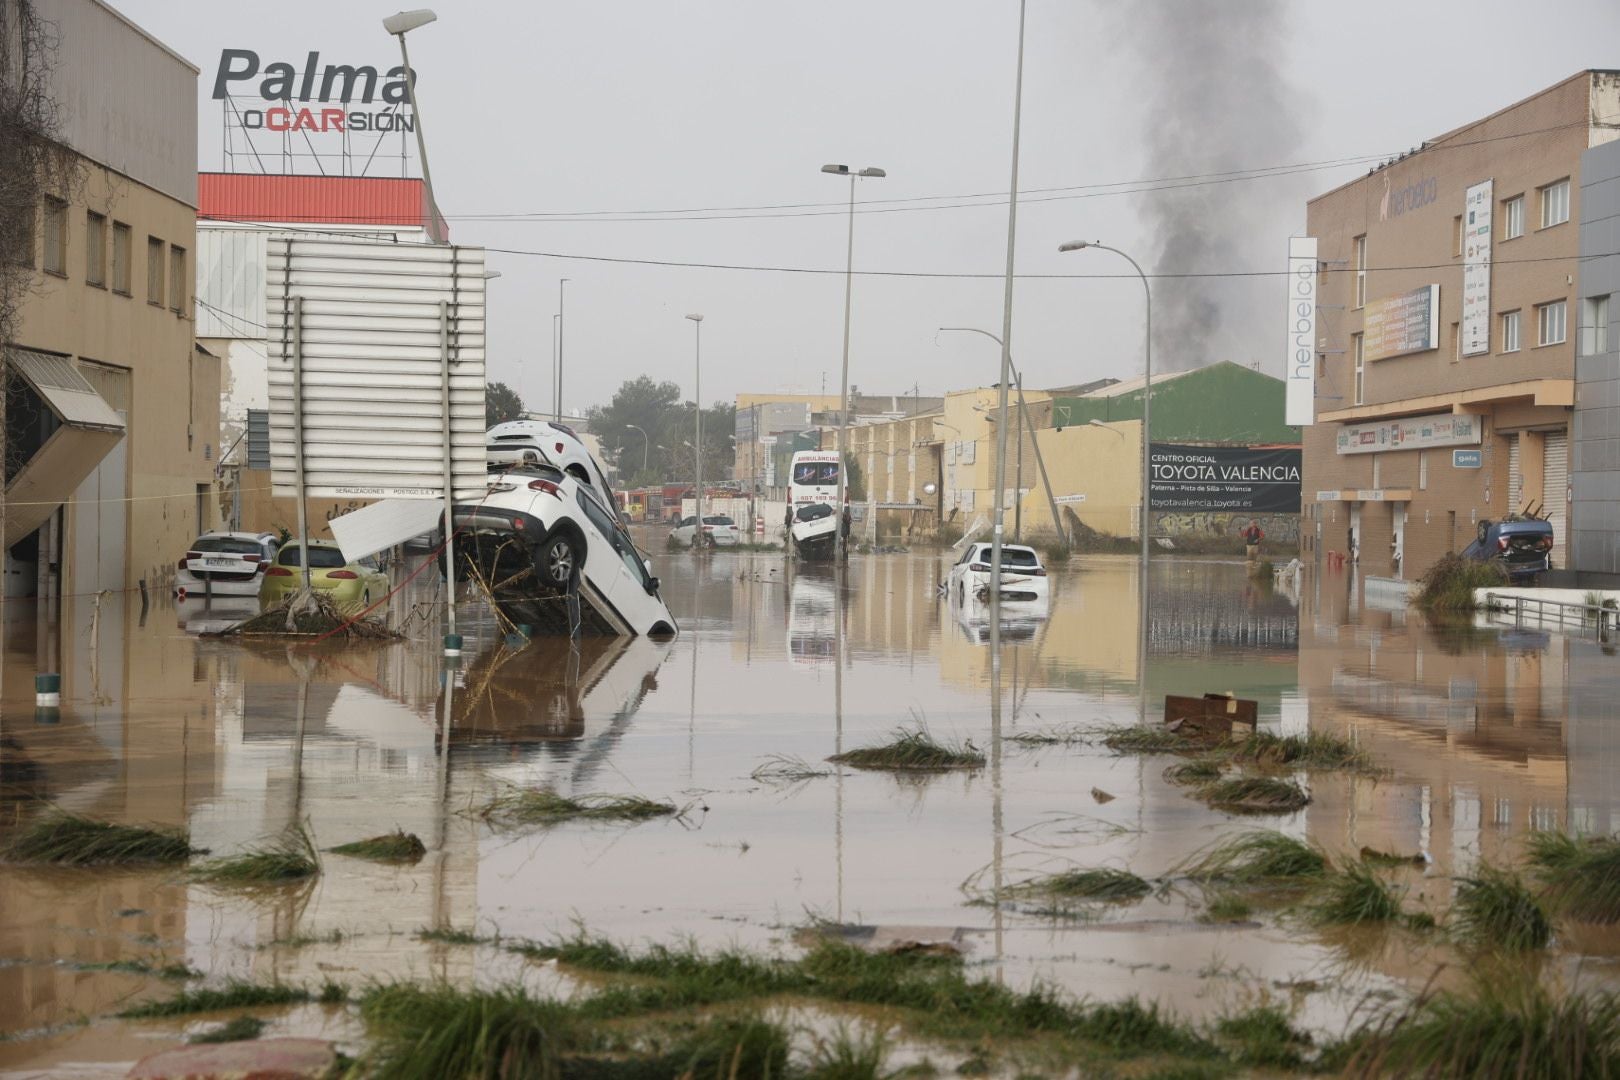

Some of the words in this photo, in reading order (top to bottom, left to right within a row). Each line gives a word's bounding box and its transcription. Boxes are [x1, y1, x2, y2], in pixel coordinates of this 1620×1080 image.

[212, 49, 416, 104] Palma
[1151, 454, 1184, 462] CENTRO
[1186, 455, 1217, 463] OFICIAL
[1151, 464, 1217, 480] TOYOTA
[1220, 465, 1300, 481] VALENCIA
[1151, 498, 1253, 508] toyotavalencia.toyota.es
